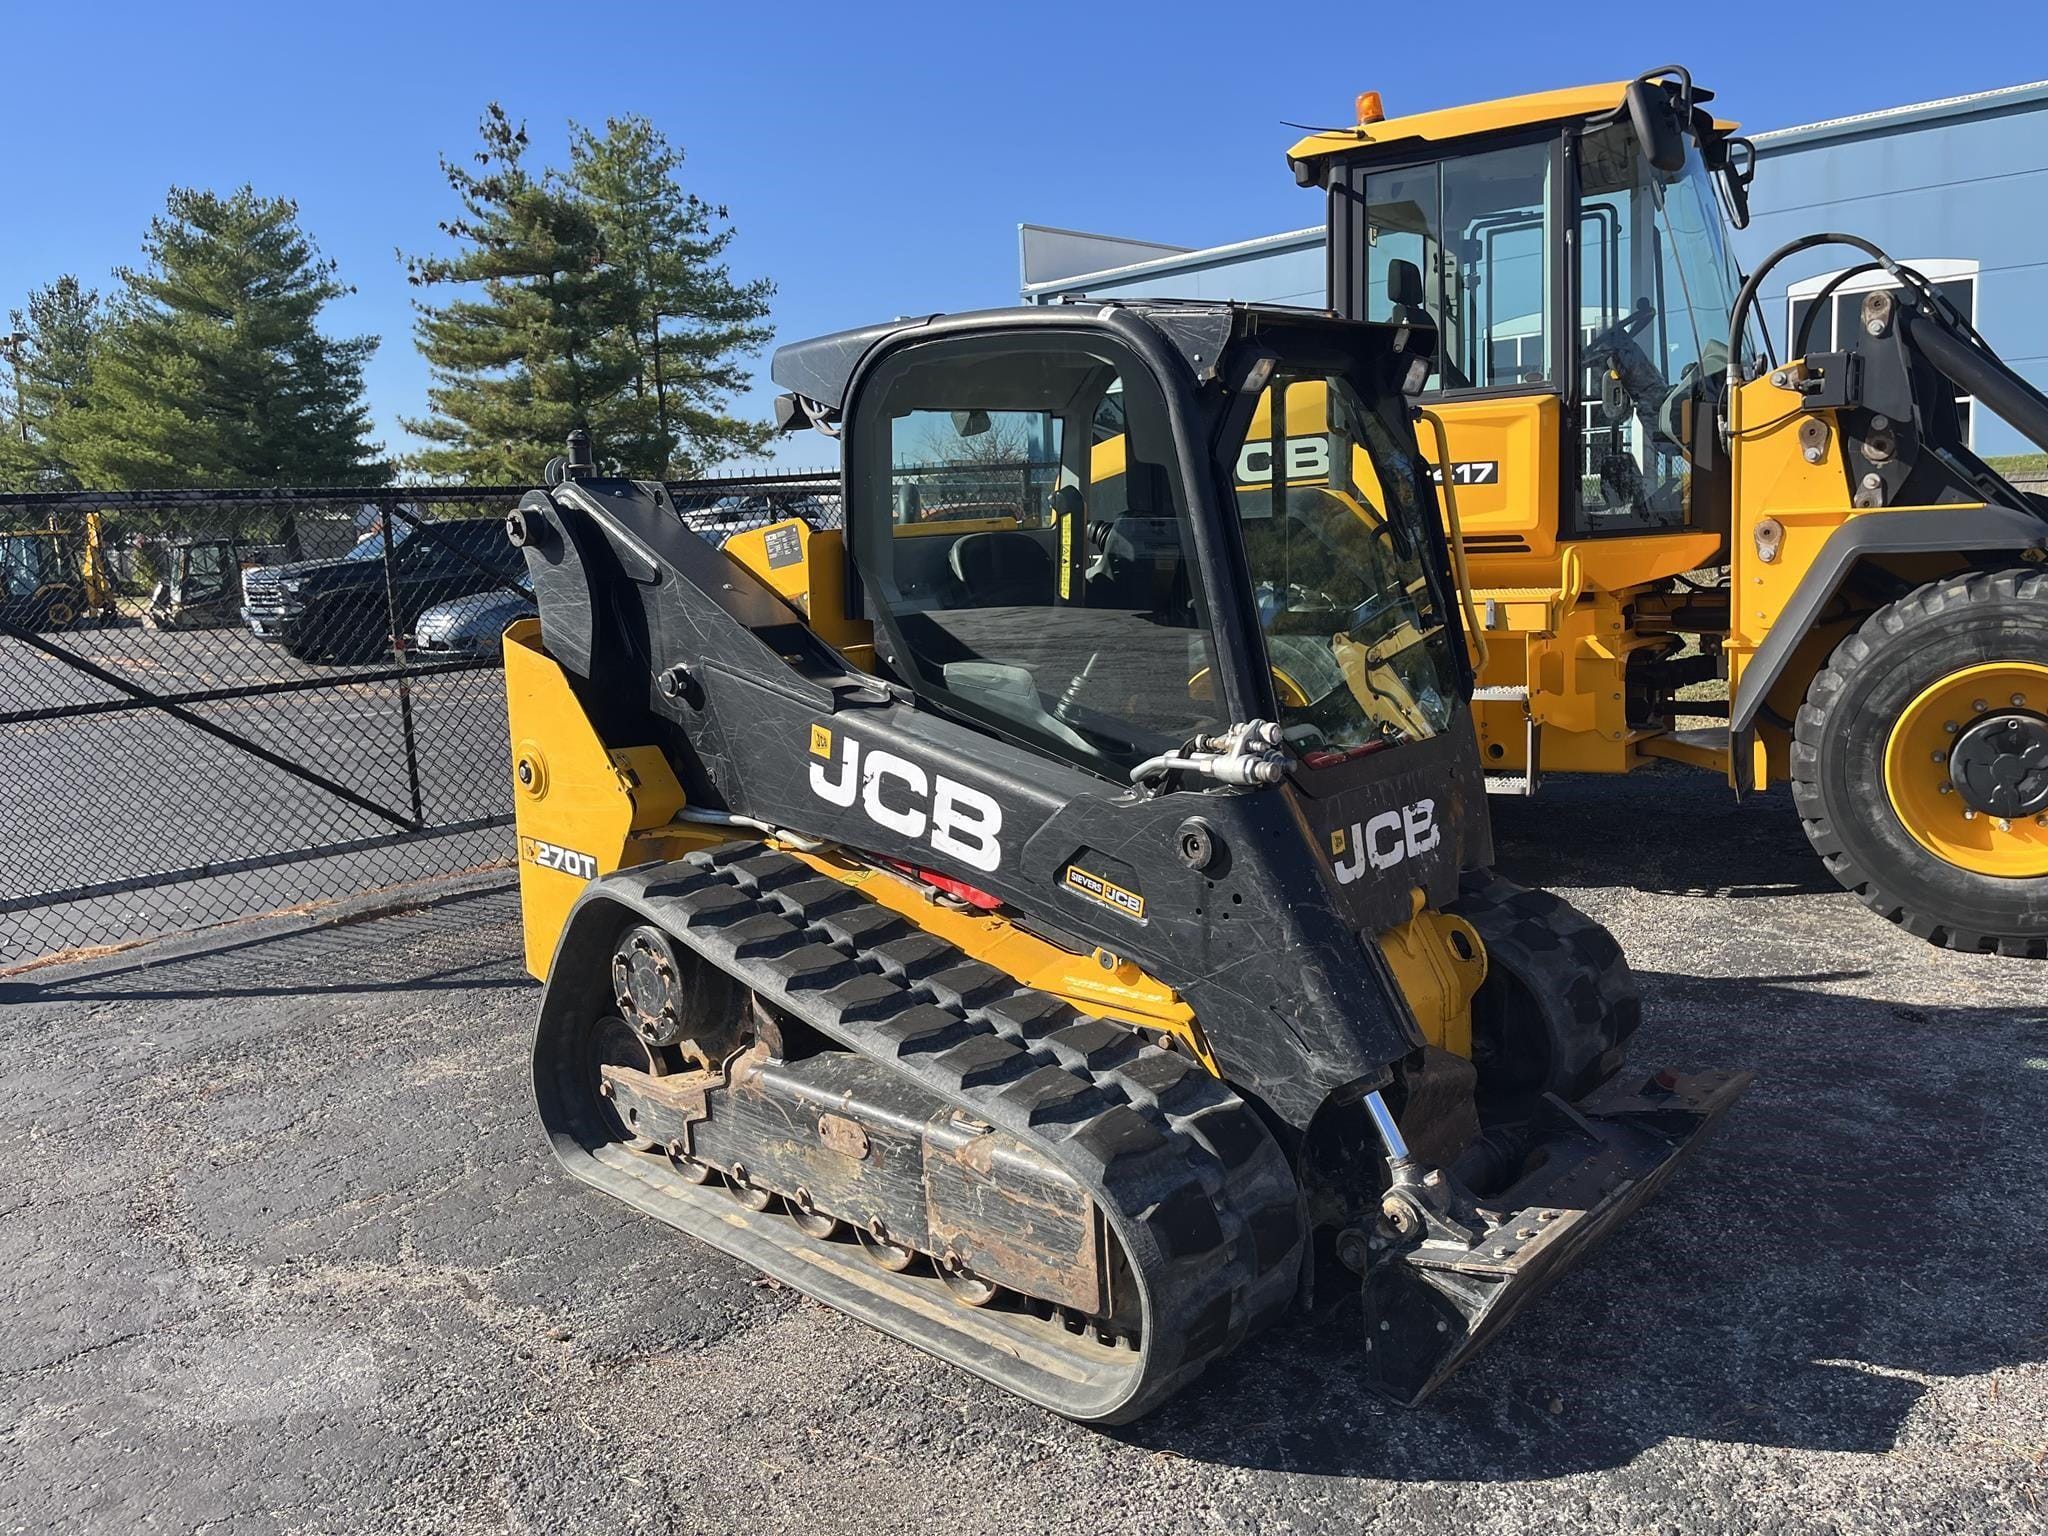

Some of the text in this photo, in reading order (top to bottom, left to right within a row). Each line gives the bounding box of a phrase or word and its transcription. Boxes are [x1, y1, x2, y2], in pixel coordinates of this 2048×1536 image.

[1236, 437, 1329, 482] CB
[809, 736, 1003, 872] JCB
[534, 841, 595, 880] 270T
[1334, 799, 1441, 884] JCB
[1070, 871, 1140, 912] SIEVERS JCB
